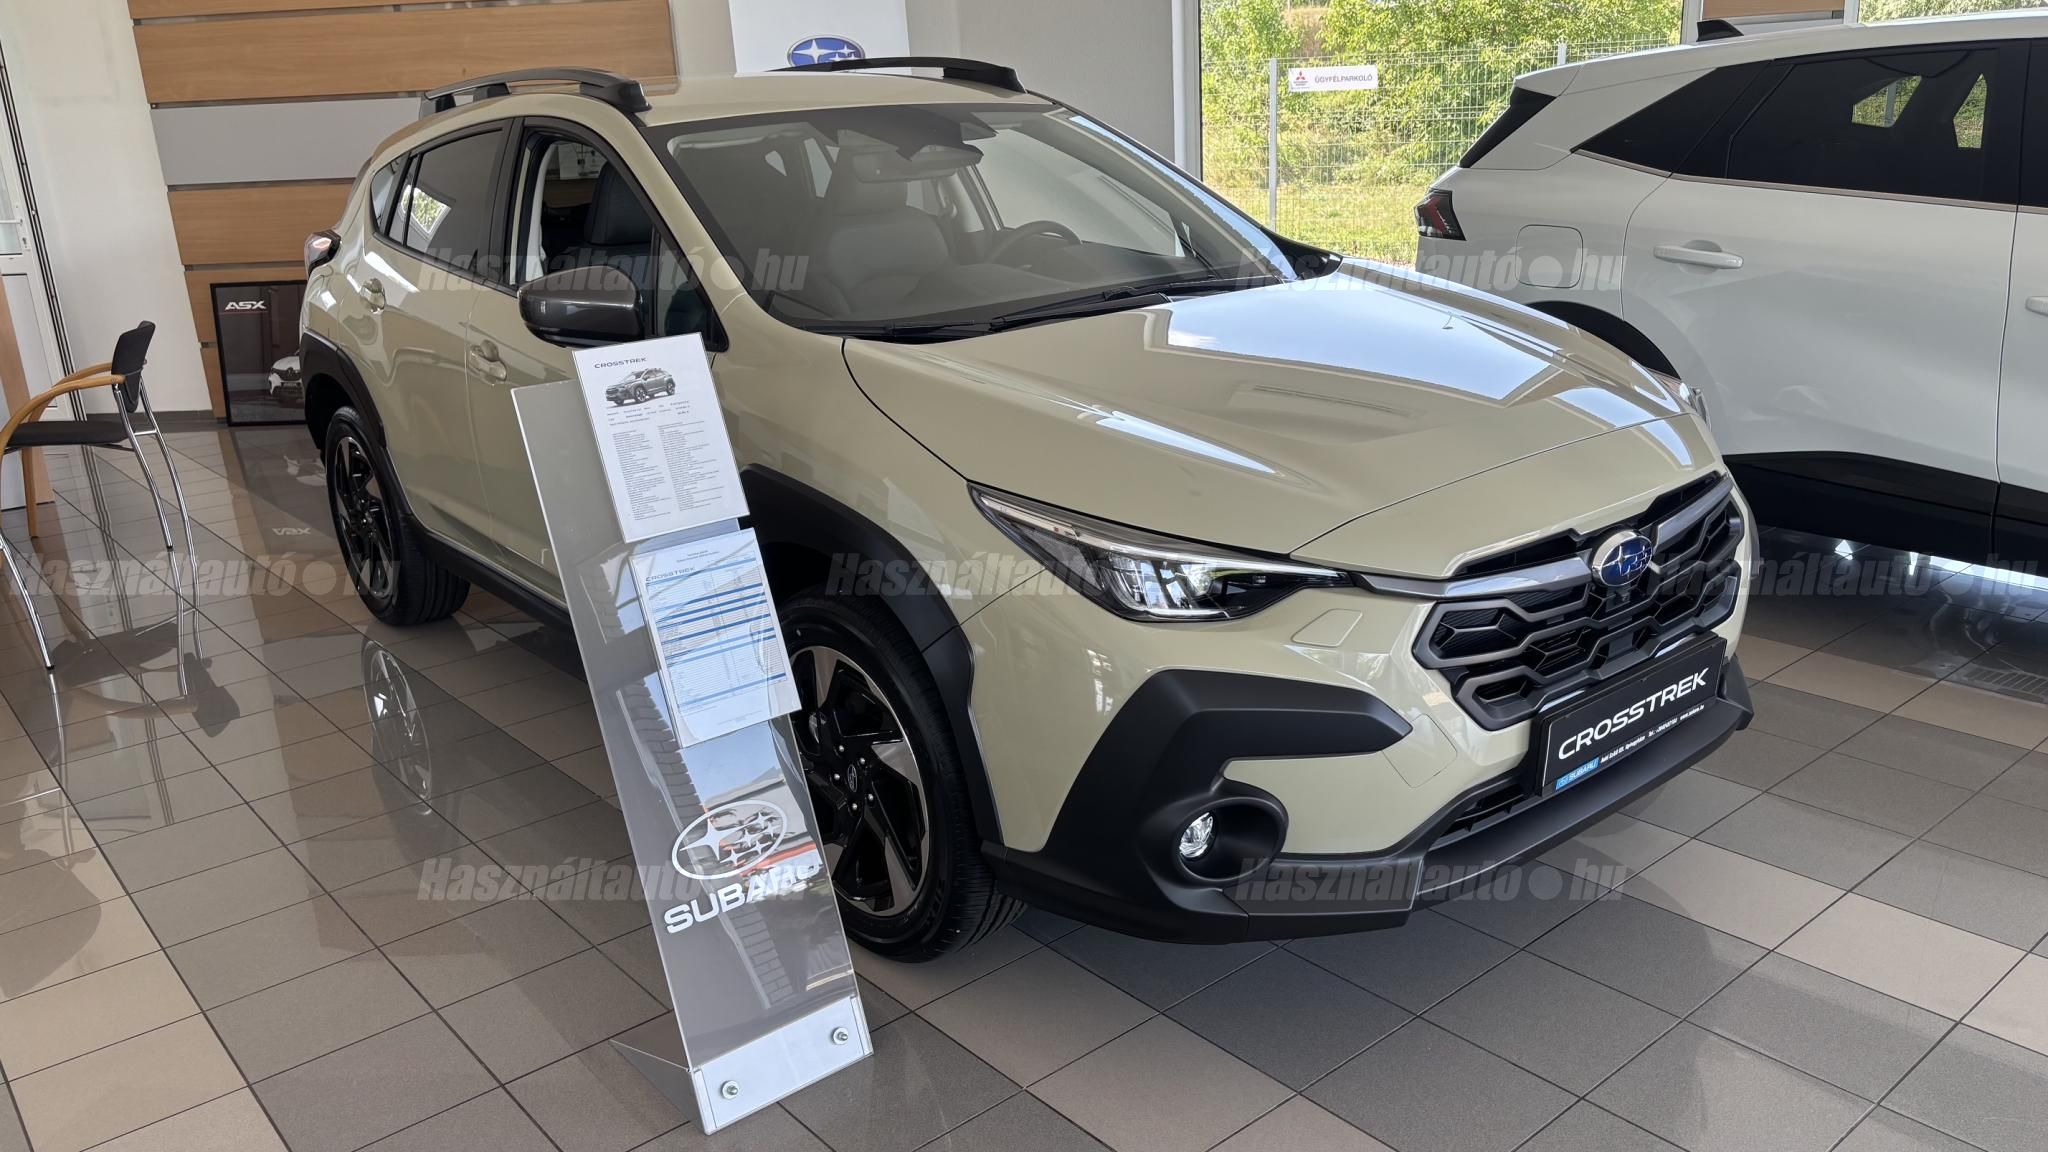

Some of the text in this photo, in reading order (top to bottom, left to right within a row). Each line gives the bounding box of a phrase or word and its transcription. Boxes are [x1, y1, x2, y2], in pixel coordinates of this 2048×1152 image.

[1314, 73, 1373, 84] ÜGYFÉLPARKOLÓ
[225, 300, 267, 311] ASX
[594, 357, 647, 369] CROSSTREK
[1558, 667, 1709, 760] CROSSTREK
